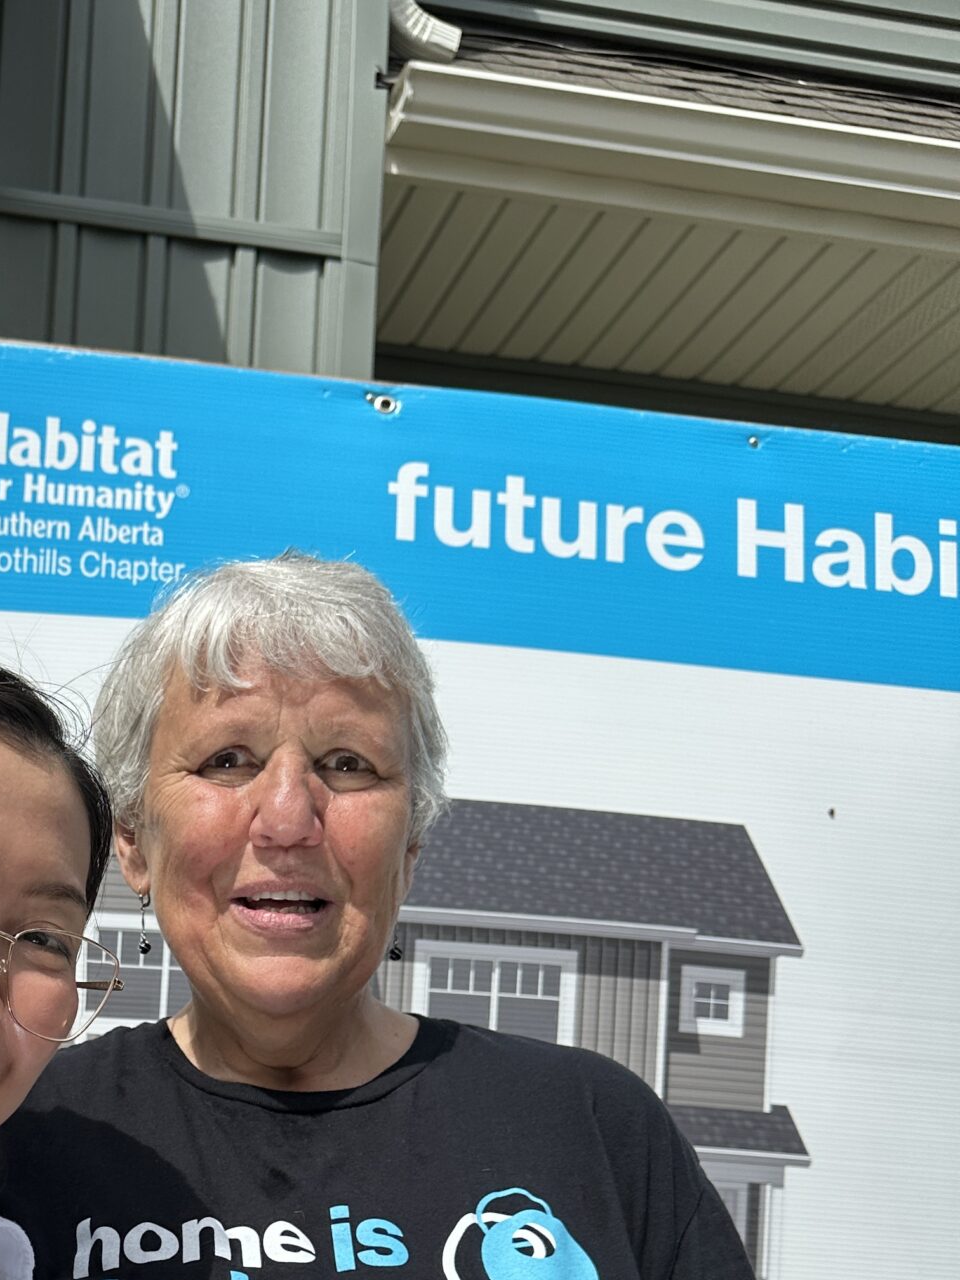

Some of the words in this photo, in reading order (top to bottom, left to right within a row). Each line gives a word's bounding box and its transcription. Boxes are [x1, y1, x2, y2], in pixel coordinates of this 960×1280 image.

[77, 514, 165, 547] Alberta
[388, 461, 705, 572] future
[736, 497, 958, 599] Habi
[79, 550, 186, 586] Chapter
[73, 1216, 316, 1279] home
[329, 1204, 410, 1272] is
